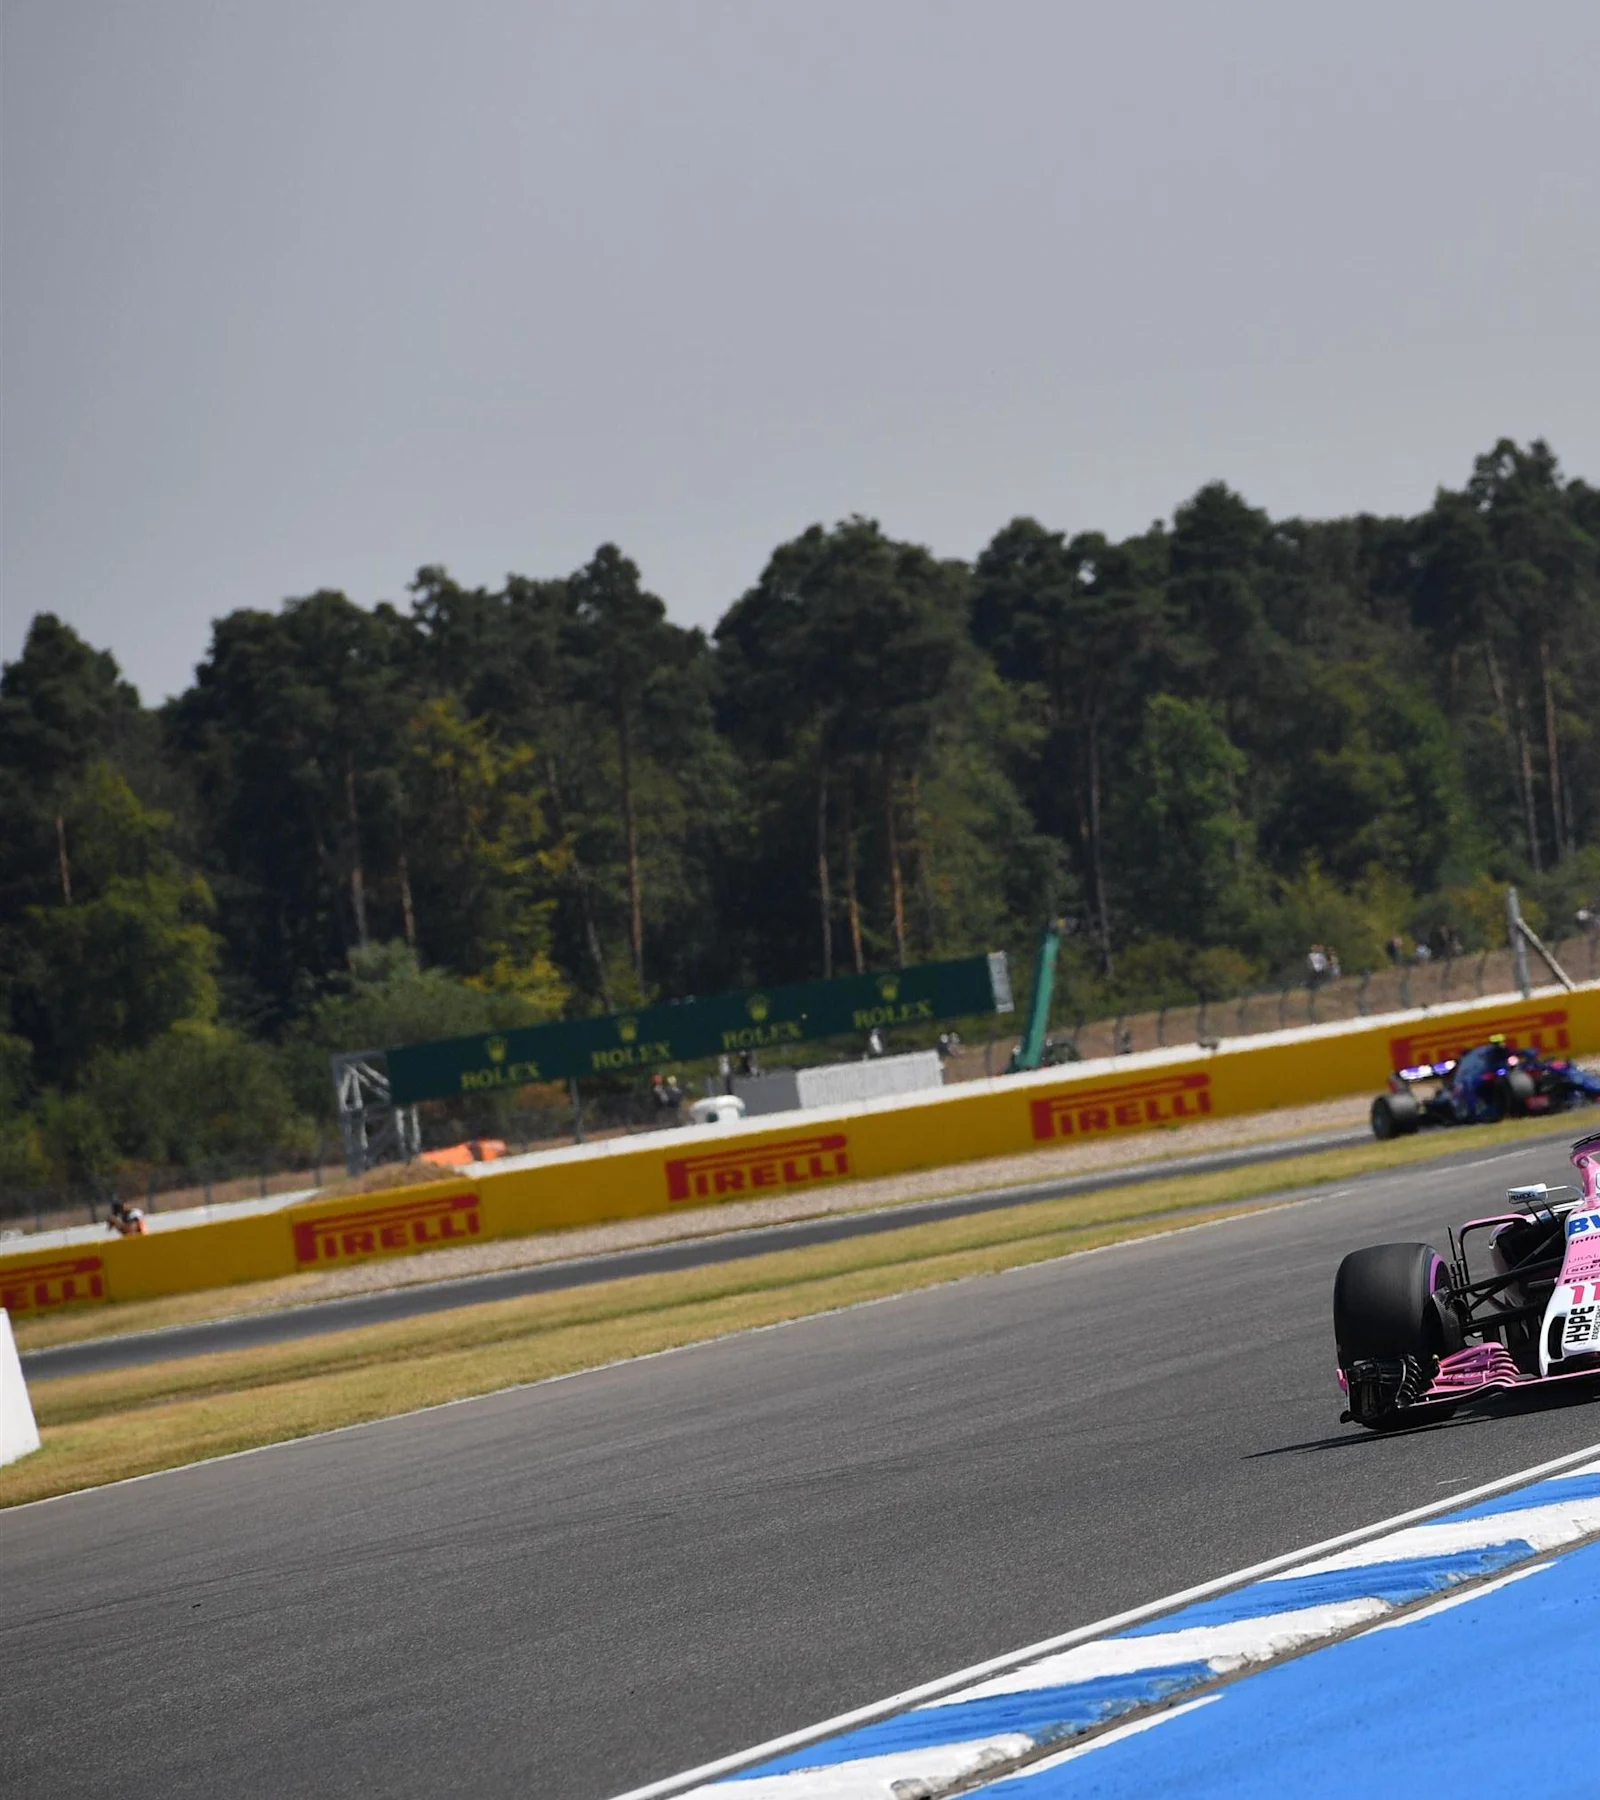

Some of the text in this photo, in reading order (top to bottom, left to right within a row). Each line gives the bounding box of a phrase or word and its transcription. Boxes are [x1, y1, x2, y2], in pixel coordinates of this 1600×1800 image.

[852, 1001, 934, 1030] ROLEX
[722, 1020, 803, 1051] ROLEX
[592, 1040, 671, 1070] ROLEX
[461, 1061, 541, 1090] ROLEX
[1031, 1073, 1211, 1139] PIRELLI
[665, 1134, 849, 1201] PIRELLI
[293, 1193, 481, 1262] PIRELLI
[1564, 1305, 1596, 1344] HYPE
